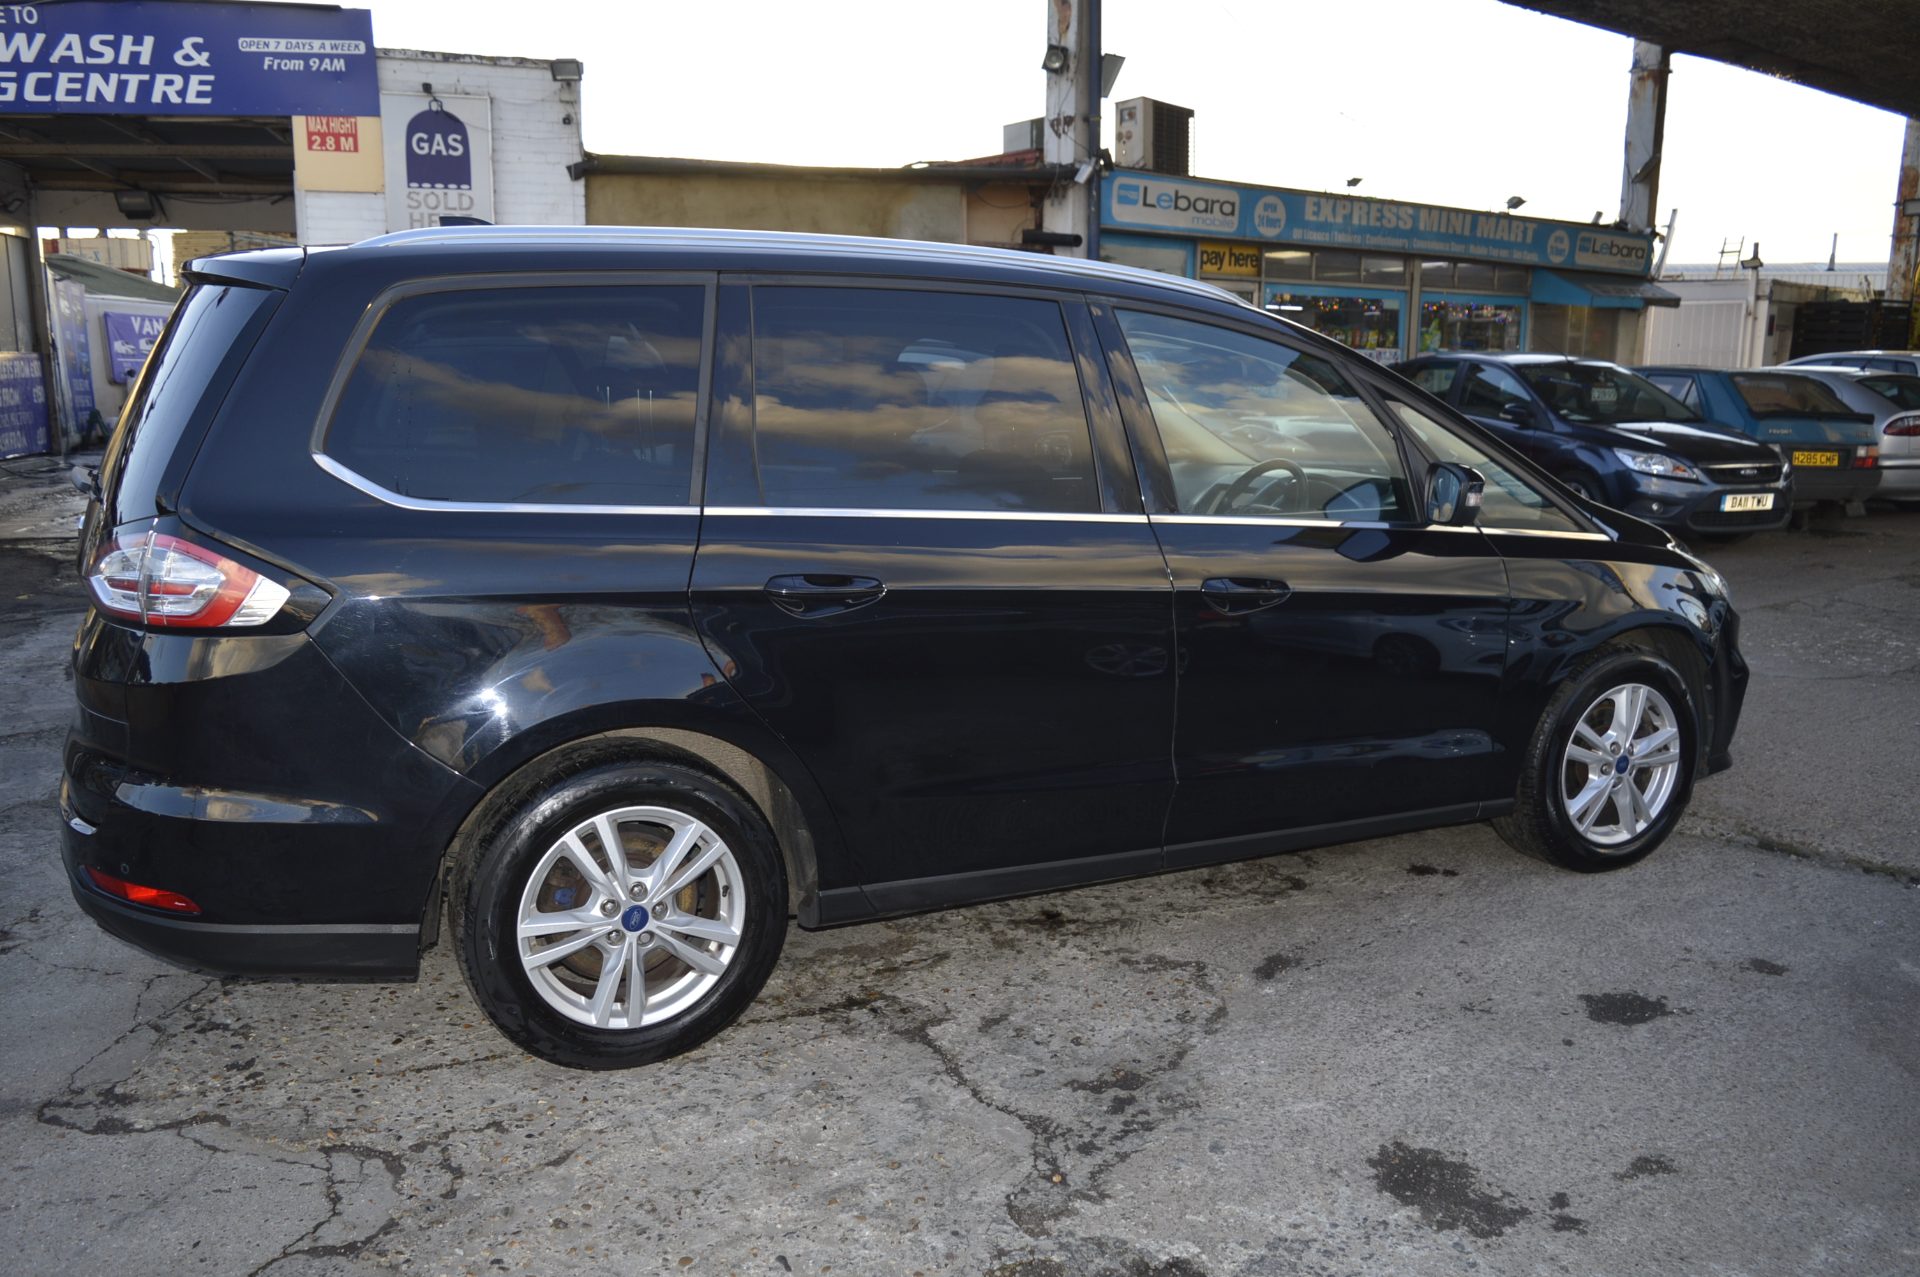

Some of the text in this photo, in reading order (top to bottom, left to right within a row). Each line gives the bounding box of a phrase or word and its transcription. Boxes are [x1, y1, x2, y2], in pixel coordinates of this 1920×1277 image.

[10, 6, 38, 24] TO
[0, 32, 211, 67] WASH &
[241, 40, 361, 52] OPEN 7 DAYS A WEEK
[263, 57, 304, 71] From
[308, 117, 356, 134] MAX HIGHT
[311, 136, 355, 151] 2.8 M
[411, 132, 464, 156] GAS
[407, 191, 474, 211] SOLD
[1142, 186, 1236, 216] Lebara
[1305, 197, 1538, 244] EXPRESS MINI MART
[1200, 246, 1259, 271] pay here
[1592, 238, 1645, 259] Lebara
